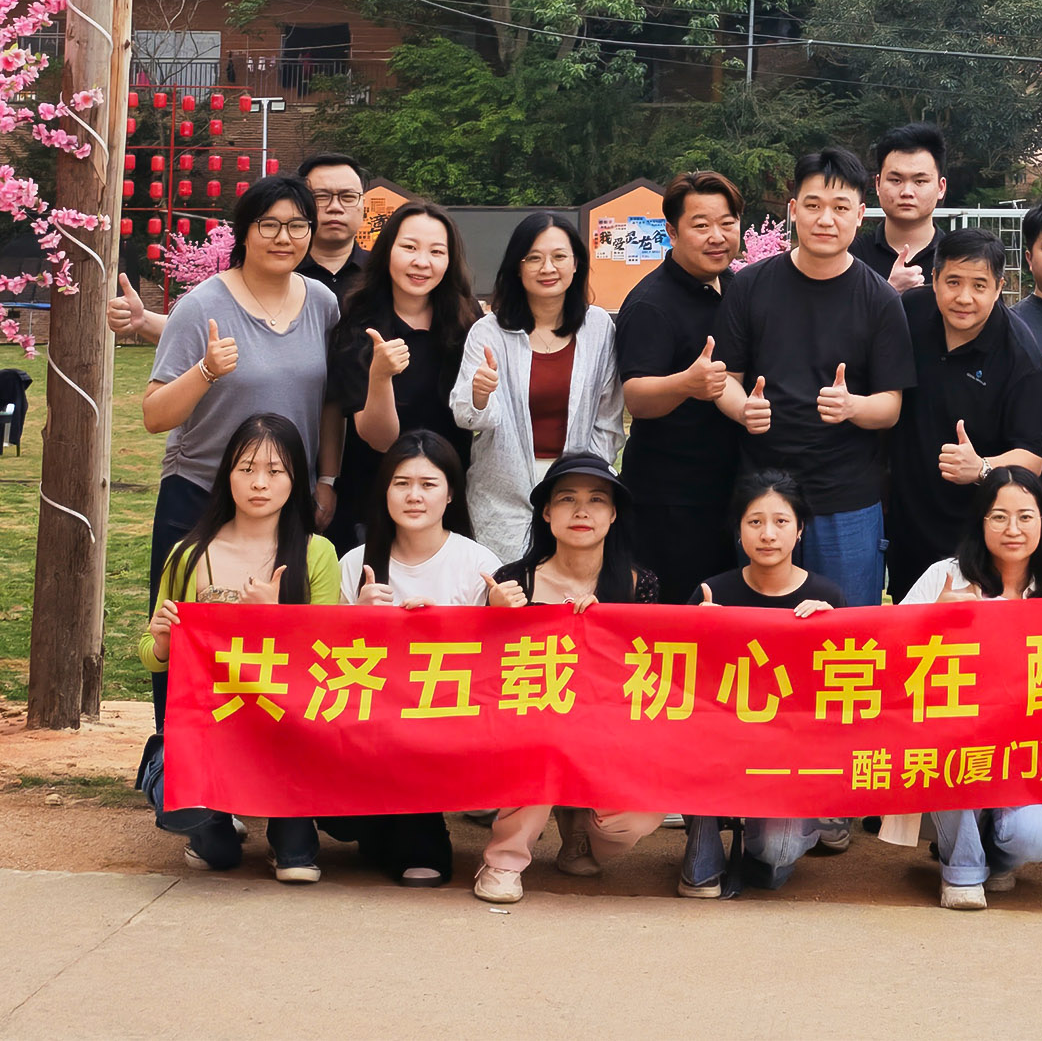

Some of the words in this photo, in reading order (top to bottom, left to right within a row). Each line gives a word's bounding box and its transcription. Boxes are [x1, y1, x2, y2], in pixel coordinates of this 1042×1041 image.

[211, 634, 579, 723] 共济五载
[622, 634, 981, 724] 初心常在
